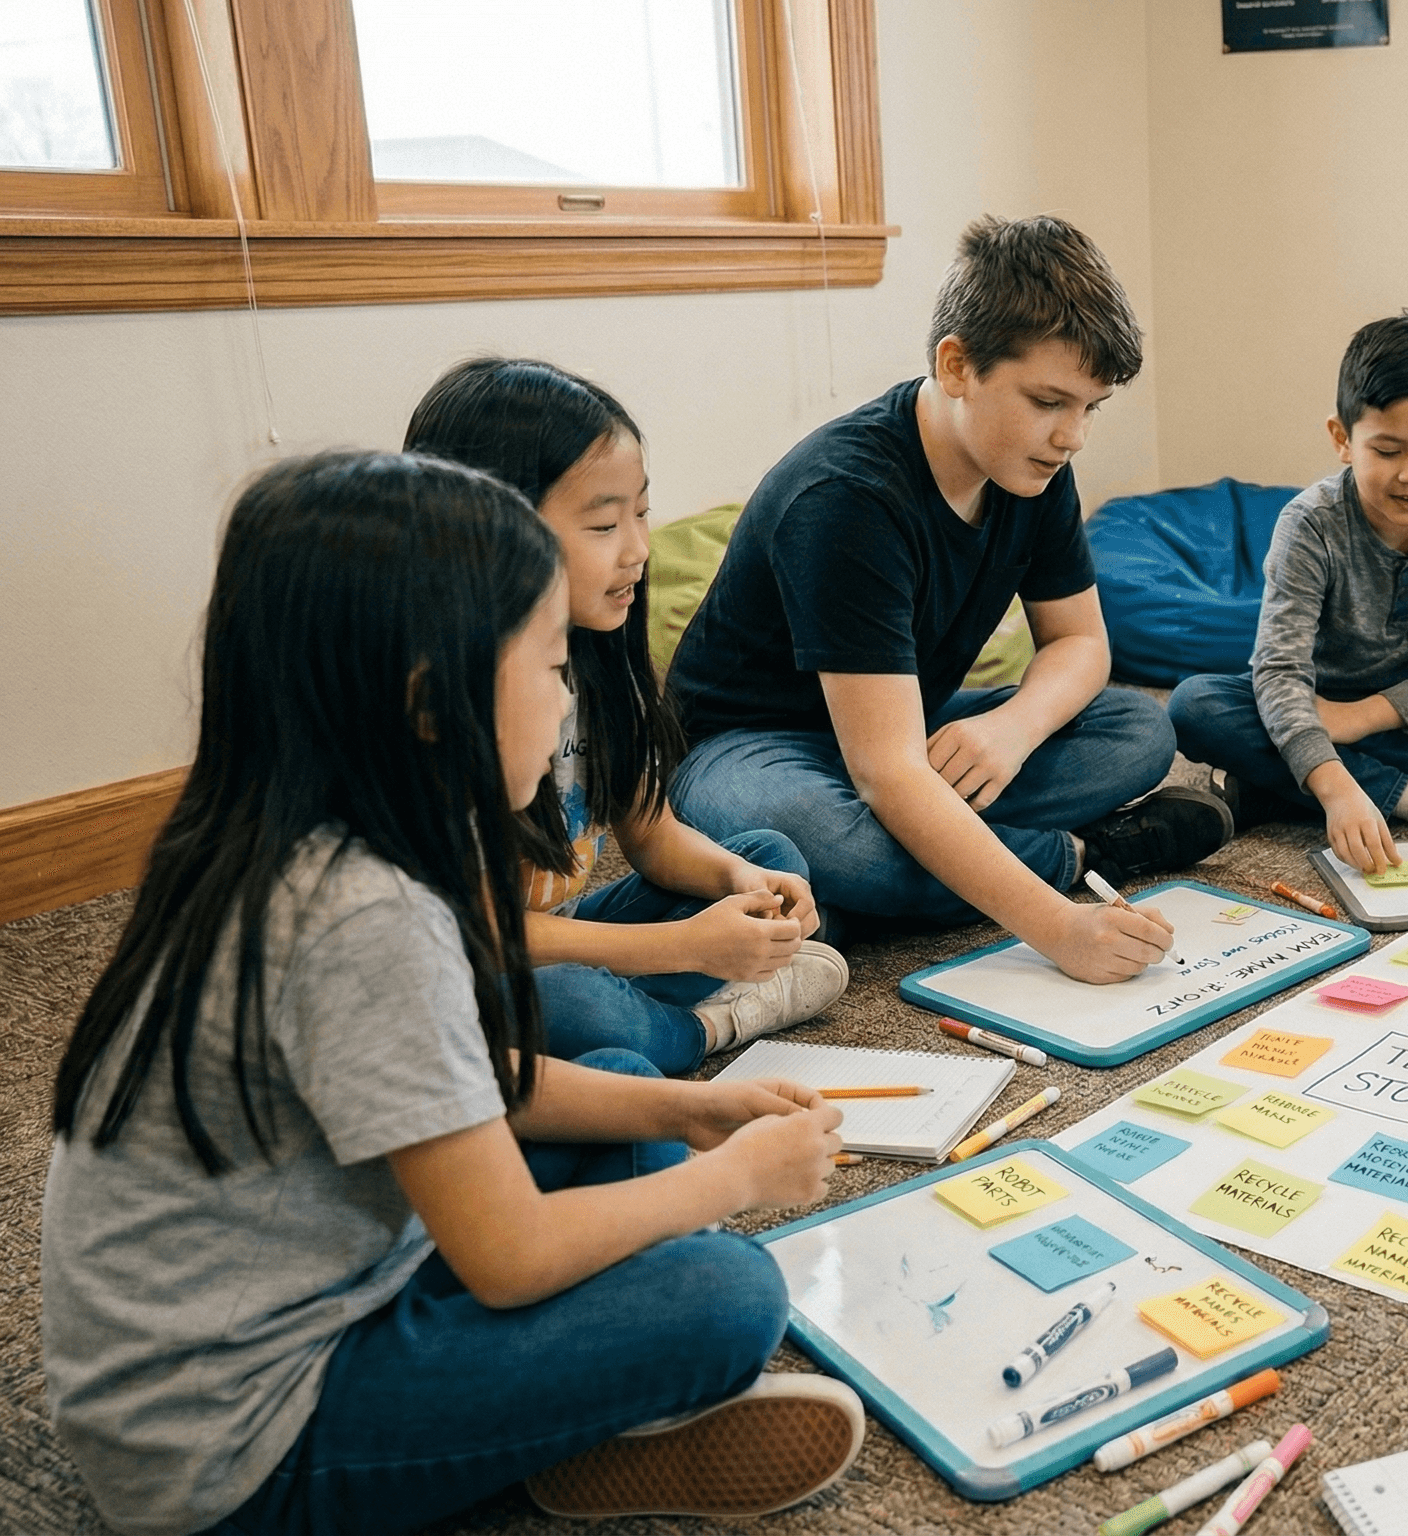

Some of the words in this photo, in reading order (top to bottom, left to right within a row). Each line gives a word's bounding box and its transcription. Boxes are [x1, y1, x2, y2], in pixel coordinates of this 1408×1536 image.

[970, 1176, 1018, 1207] PARTS
[995, 1166, 1046, 1198] ROBOT
[1233, 1169, 1305, 1201] RECYCLE
[1216, 1183, 1296, 1219] MATERIALS
[1206, 1281, 1266, 1319] RECYCLE
